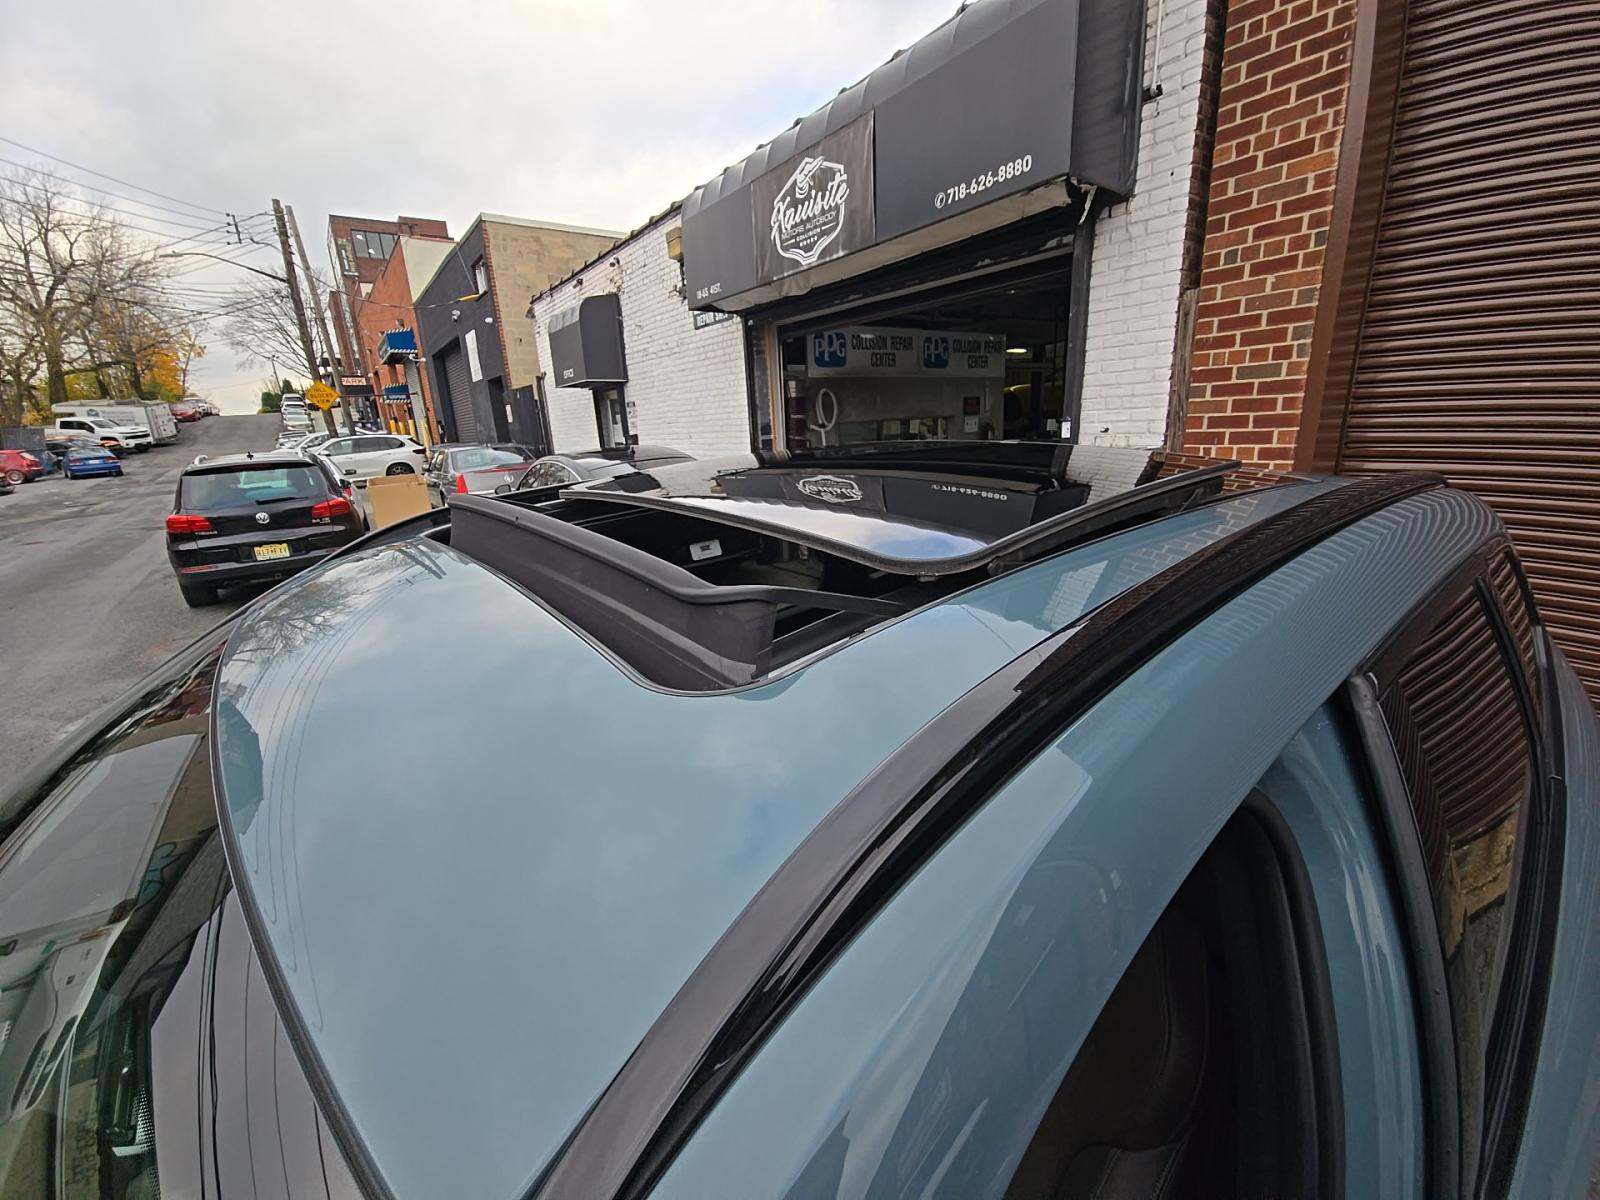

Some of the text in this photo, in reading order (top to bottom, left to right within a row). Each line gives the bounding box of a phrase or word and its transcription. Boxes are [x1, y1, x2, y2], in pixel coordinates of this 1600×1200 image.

[946, 154, 1032, 205] 718-626-8880
[771, 172, 849, 240] Xquisite
[806, 211, 837, 229] AUTOBODY
[815, 332, 846, 361] PPG
[851, 334, 914, 351] COLLISION REPAIR
[924, 336, 949, 362] PPG
[952, 338, 981, 354] COLLISION
[870, 352, 896, 367] CENTER
[967, 354, 989, 369] CENTER
